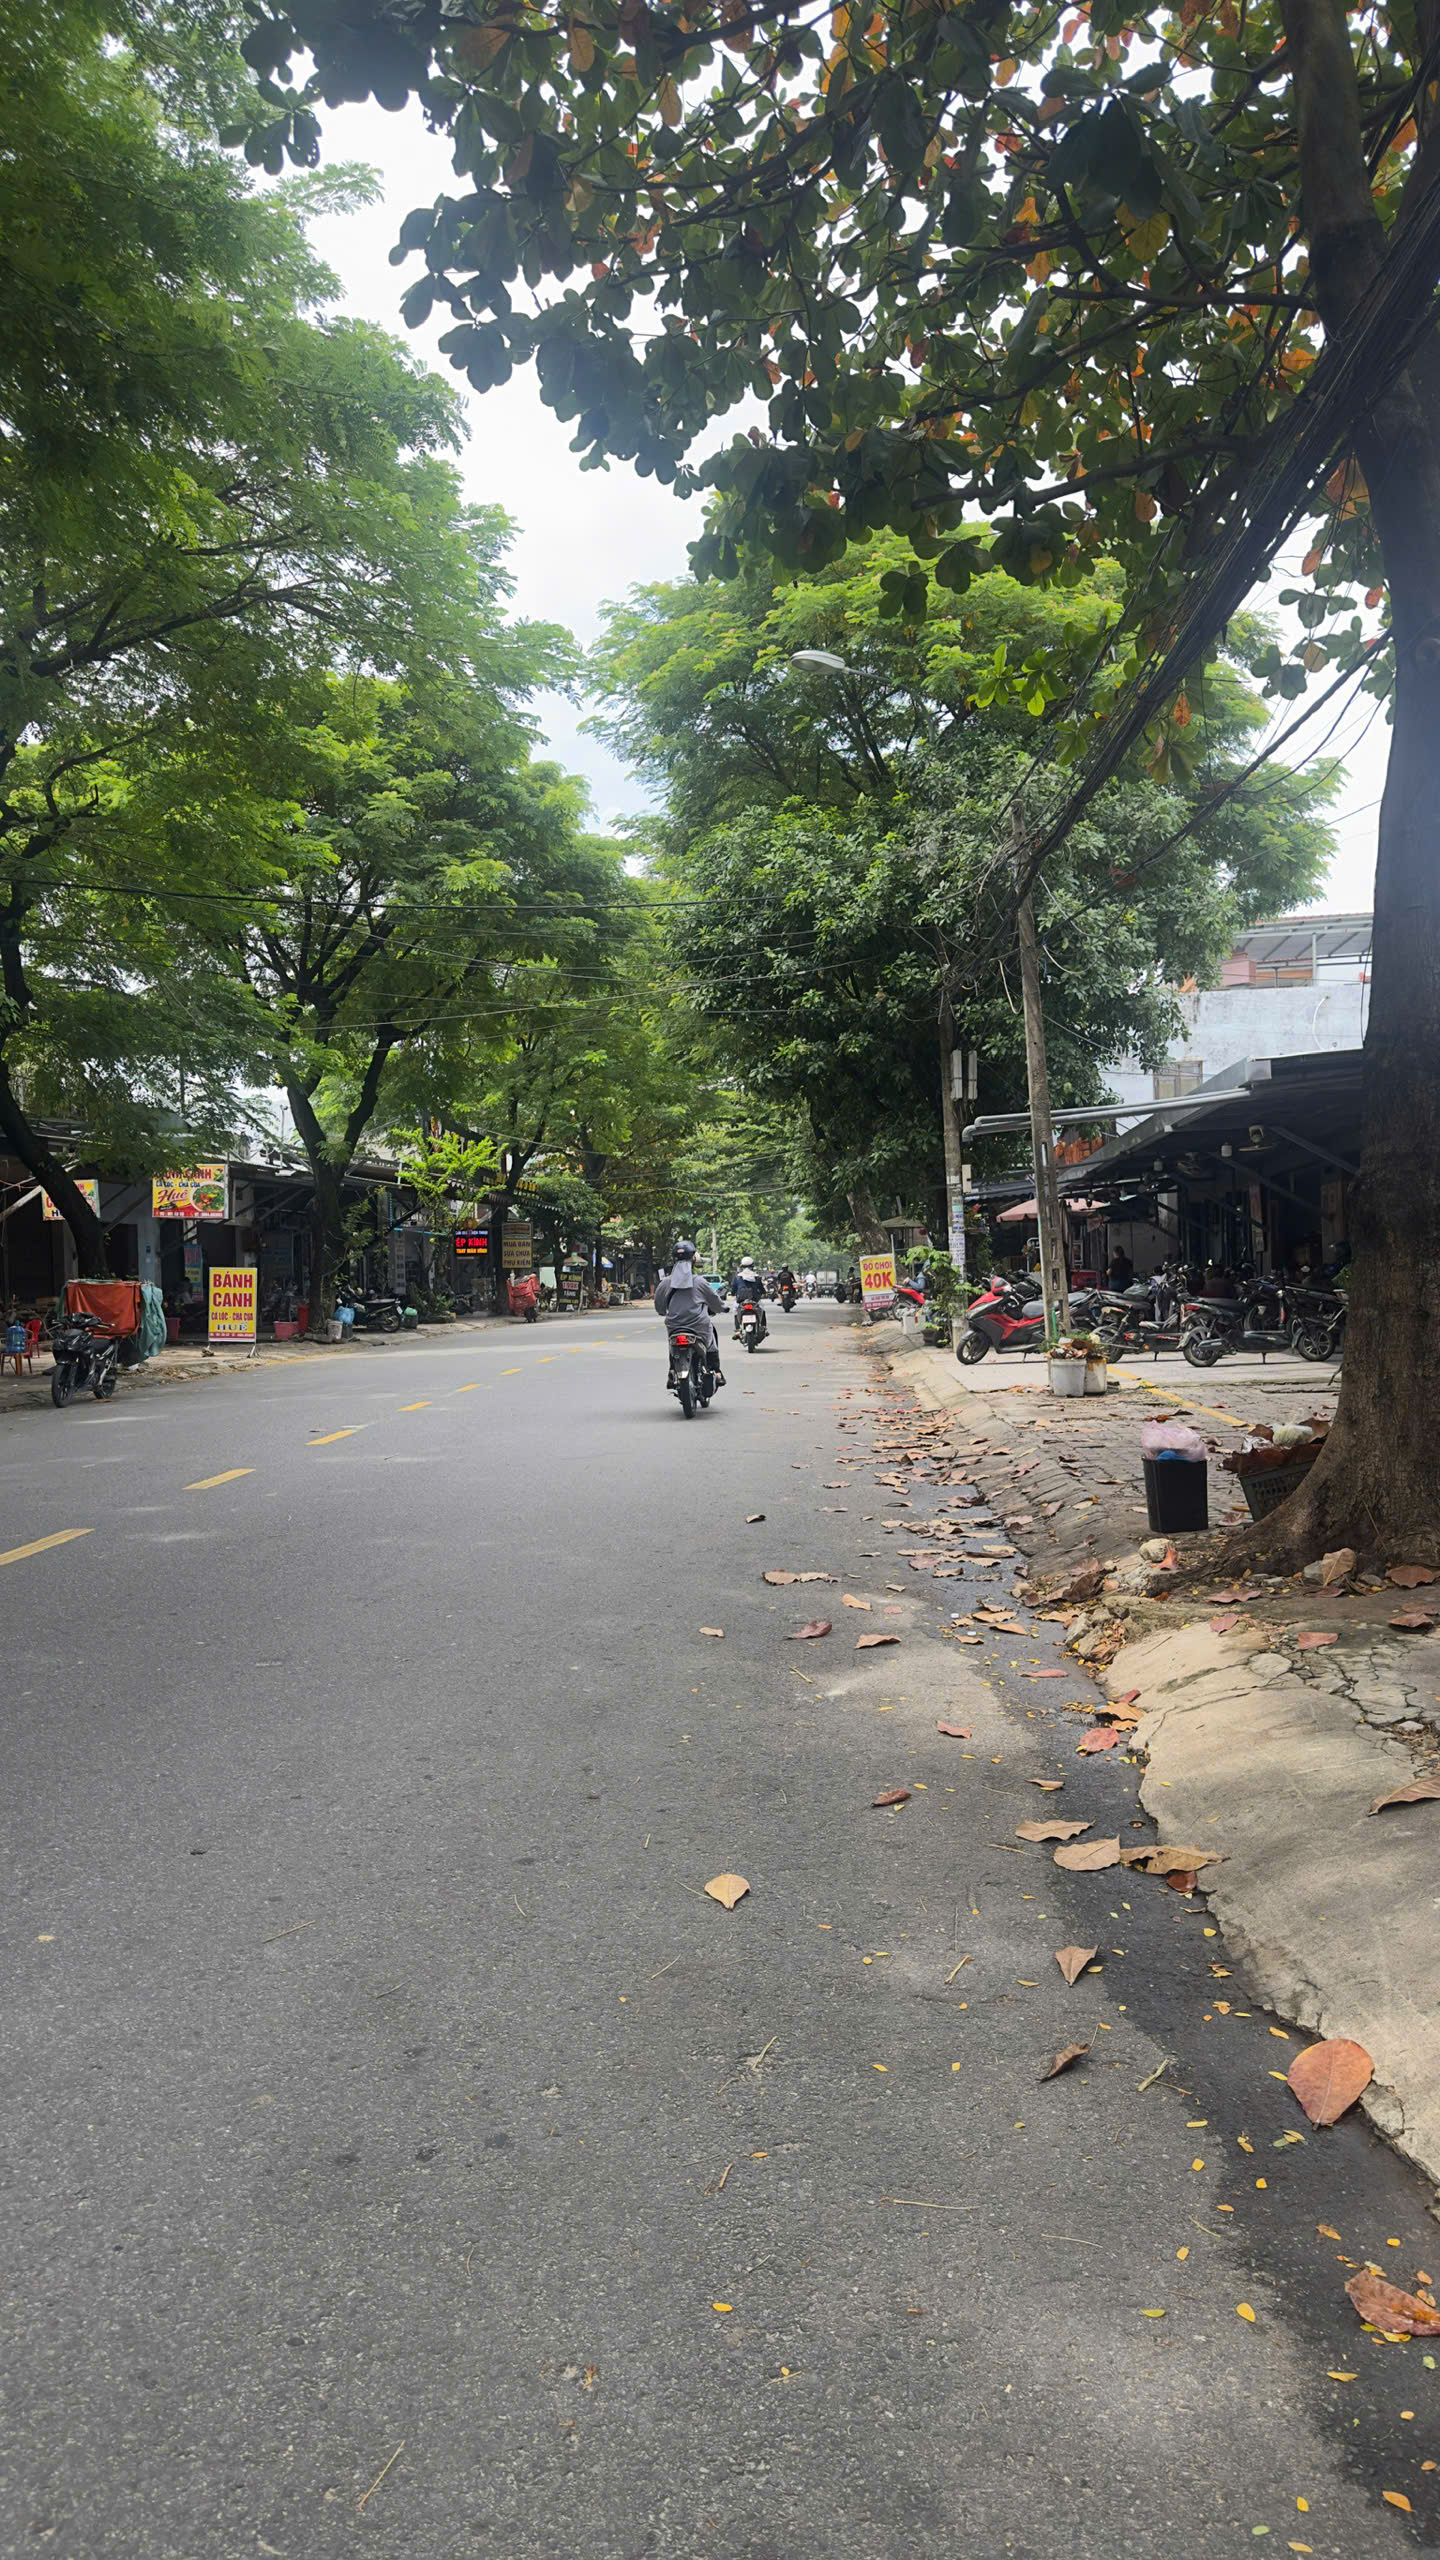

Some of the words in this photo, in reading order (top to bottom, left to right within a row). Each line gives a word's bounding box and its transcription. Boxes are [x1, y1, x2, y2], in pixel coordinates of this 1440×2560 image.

[213, 1271, 252, 1288] BÁNH
[865, 1272, 893, 1288] 40K
[213, 1293, 252, 1307] CANH
